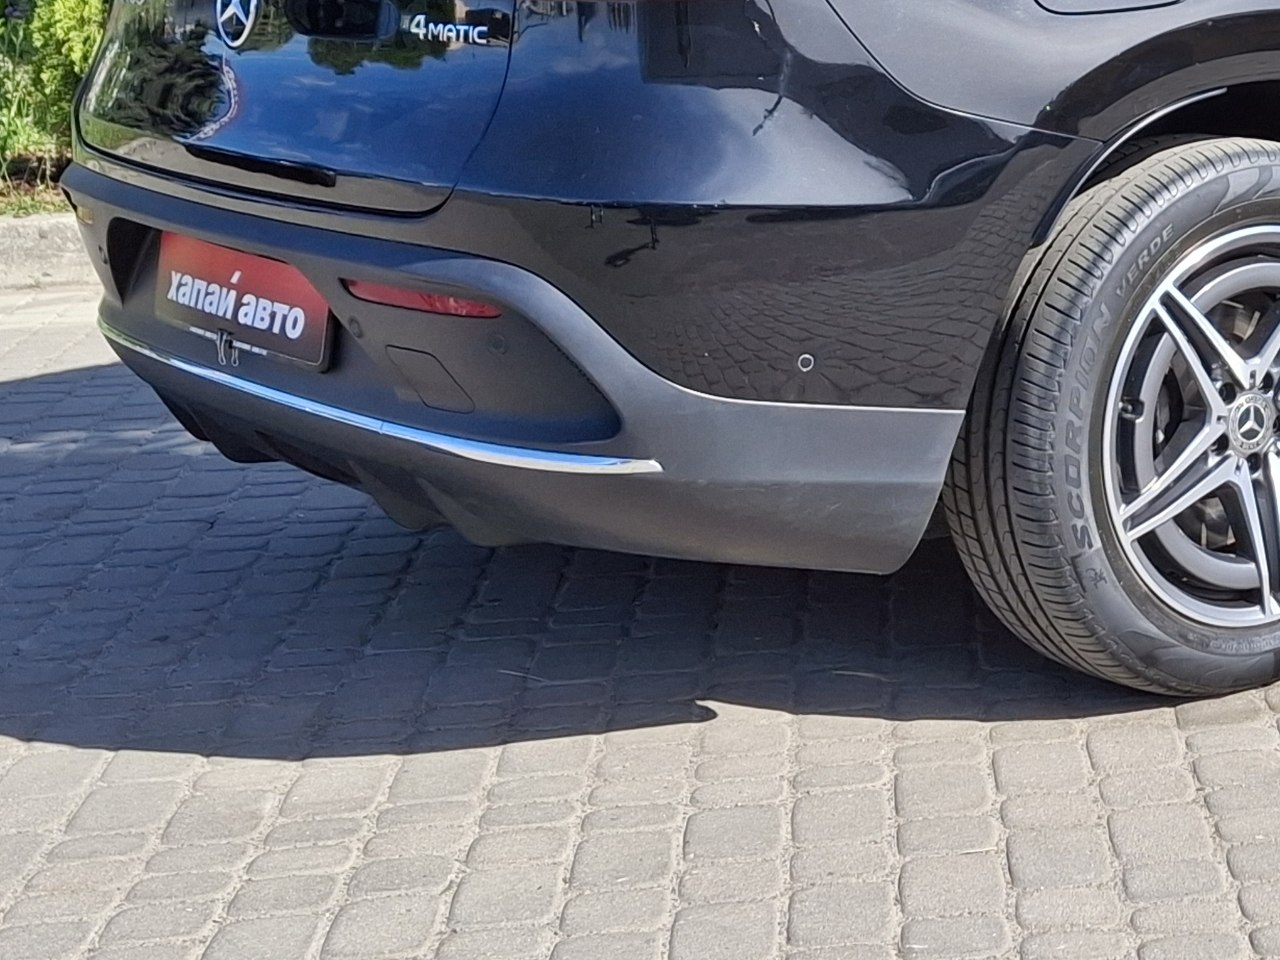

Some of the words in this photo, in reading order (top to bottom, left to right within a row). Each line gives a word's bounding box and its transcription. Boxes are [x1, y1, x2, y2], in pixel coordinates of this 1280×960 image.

[410, 14, 488, 44] 4MATIC
[166, 270, 242, 320] хапай
[237, 294, 305, 339] авто
[1065, 302, 1112, 552] SCORPION
[1116, 223, 1174, 297] VERDE
